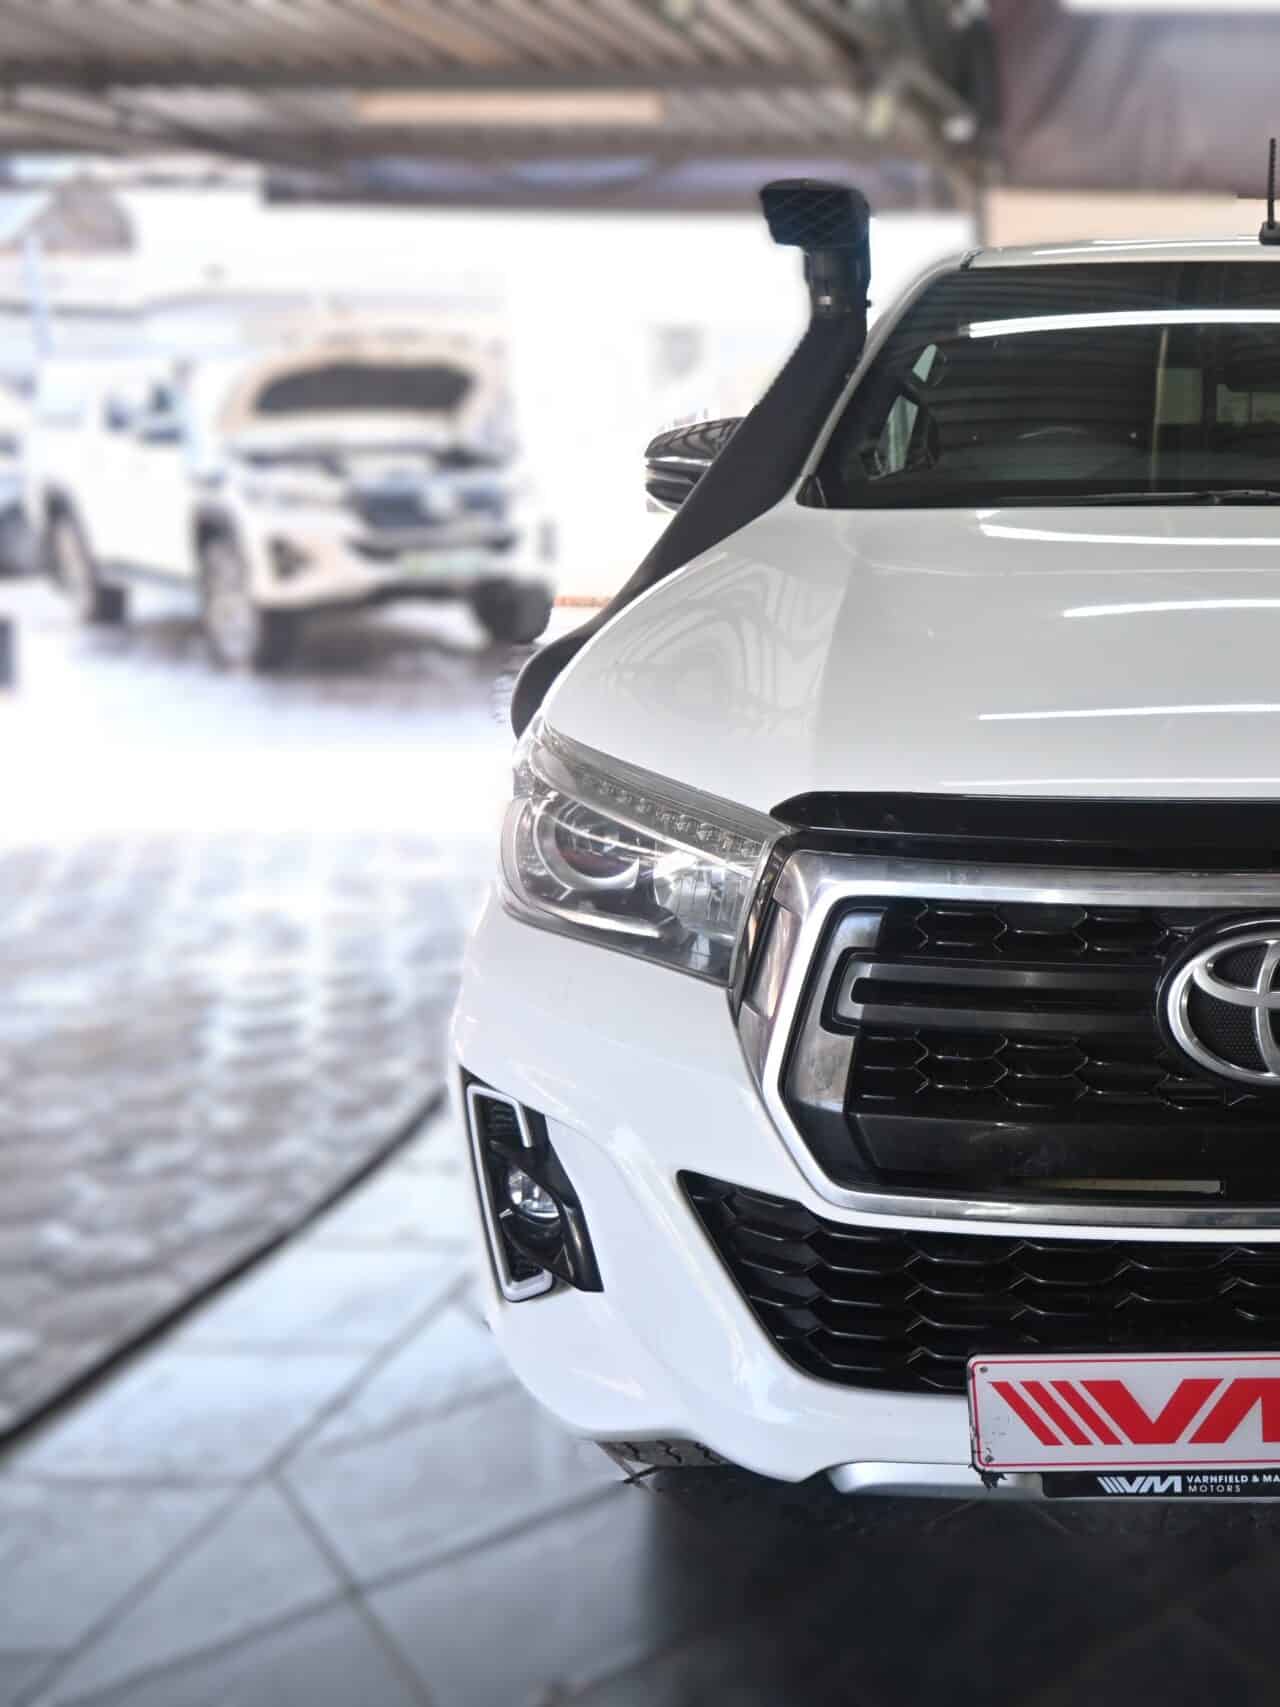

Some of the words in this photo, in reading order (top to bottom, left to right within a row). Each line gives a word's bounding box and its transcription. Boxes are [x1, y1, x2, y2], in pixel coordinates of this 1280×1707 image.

[1186, 1475, 1249, 1484] VARNFIELD
[1251, 1474, 1259, 1483] &
[1117, 1476, 1182, 1494] VM
[1188, 1484, 1241, 1493] MOTORS
